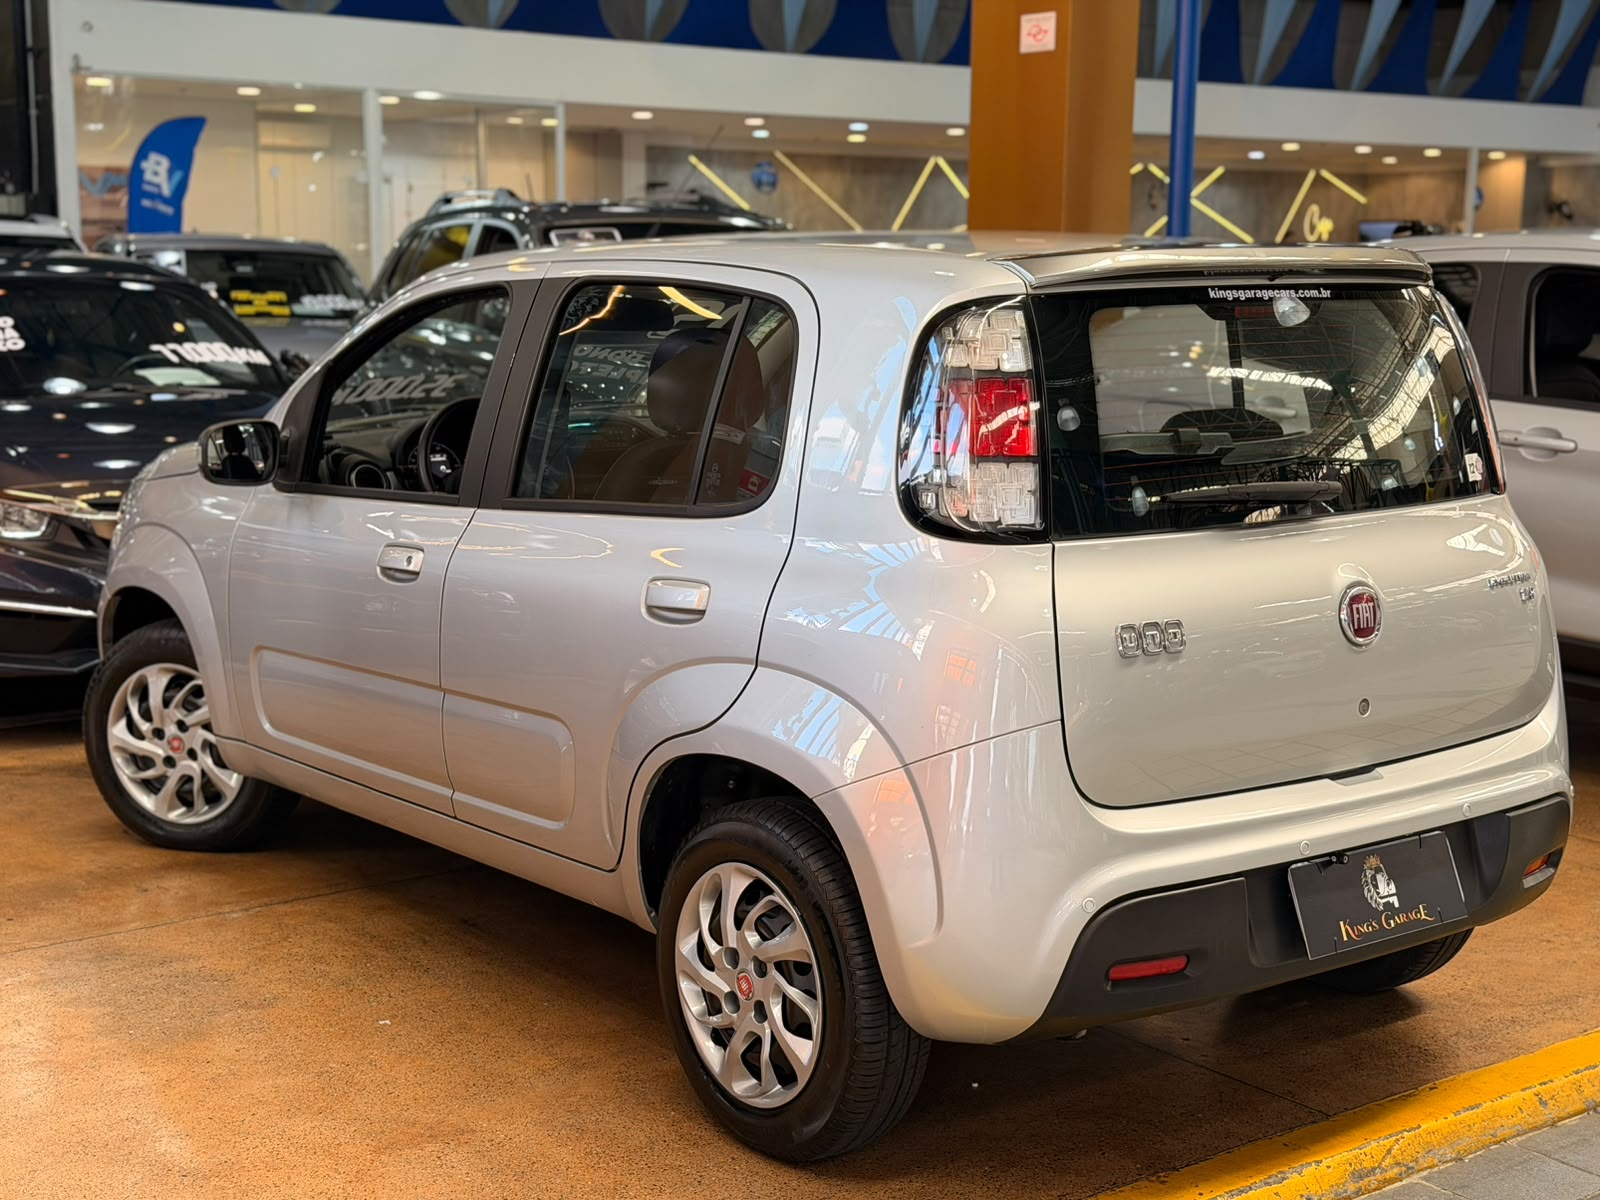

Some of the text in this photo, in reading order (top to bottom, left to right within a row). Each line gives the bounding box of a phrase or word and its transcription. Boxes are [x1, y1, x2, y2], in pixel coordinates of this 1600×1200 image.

[1208, 287, 1332, 300] kingsgaragecars.com.br
[1351, 602, 1375, 630] FIAT
[1339, 903, 1436, 942] KING'S GARAGE
